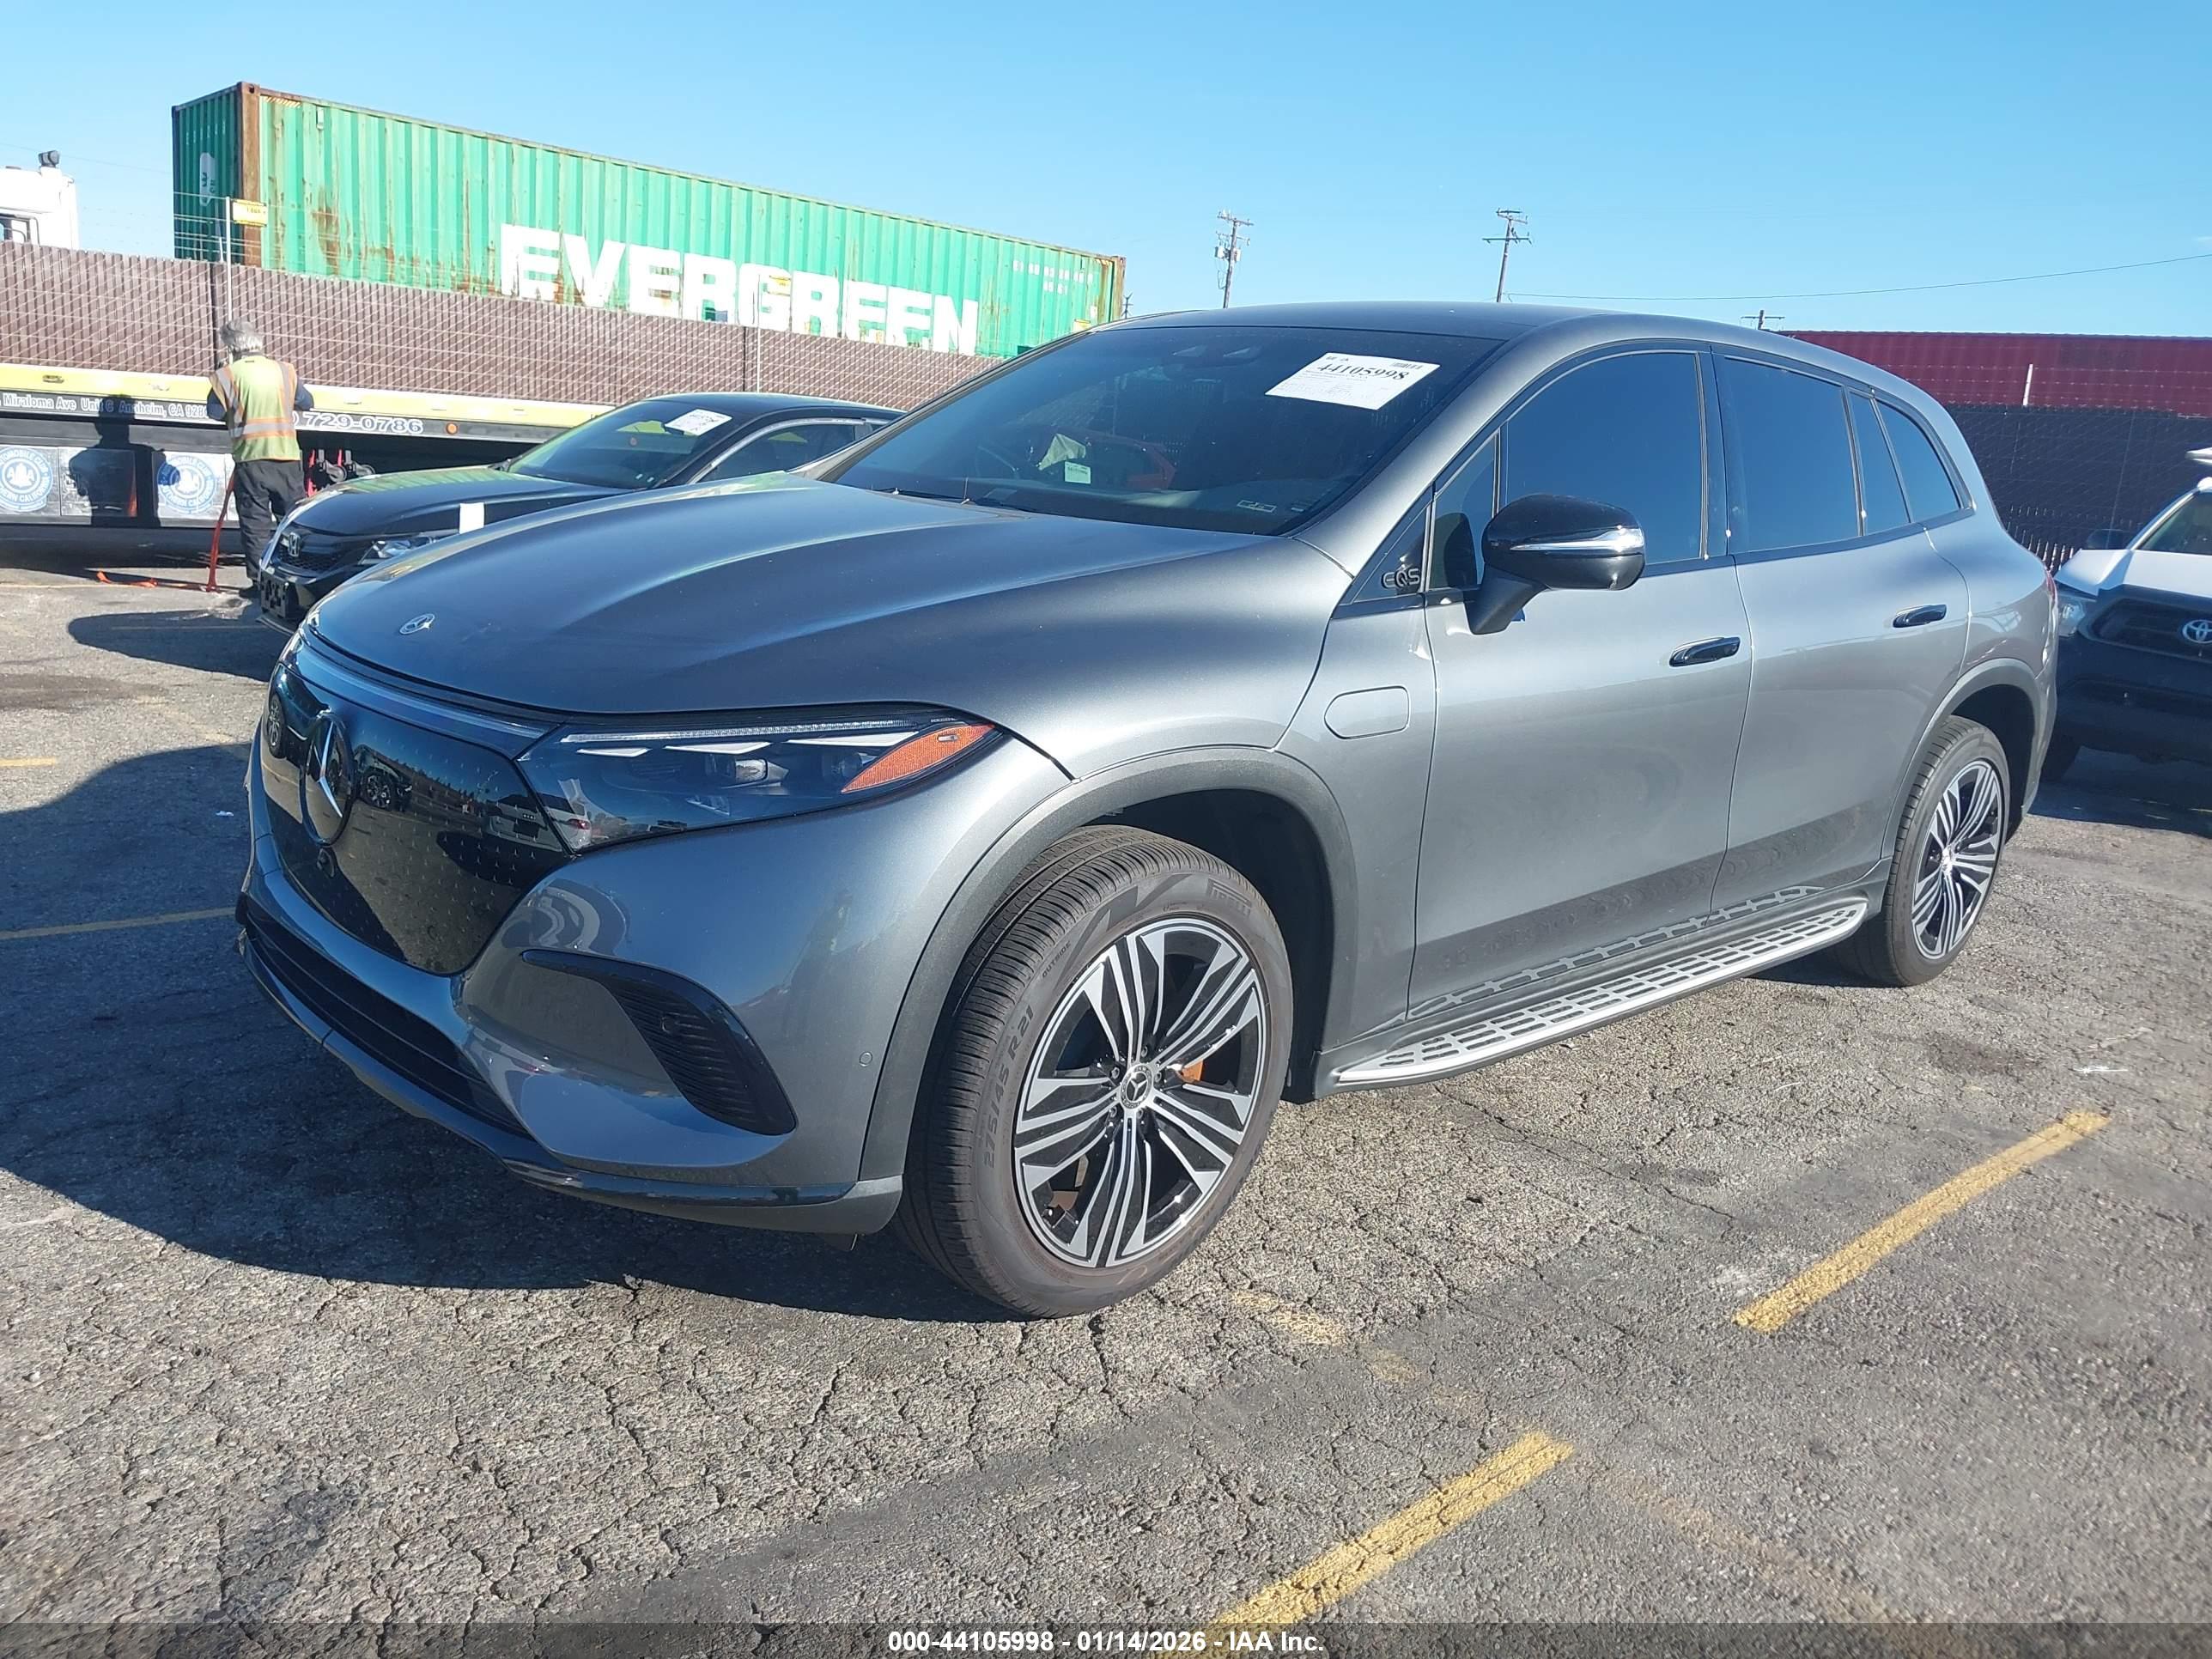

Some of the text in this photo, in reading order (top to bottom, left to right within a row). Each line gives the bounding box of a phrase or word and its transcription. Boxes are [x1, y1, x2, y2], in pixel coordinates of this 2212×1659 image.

[501, 223, 978, 356] EVERGREEN
[1317, 362, 1411, 380] 44105998
[3, 392, 55, 409] Miraloma
[56, 396, 77, 410] Ave
[81, 397, 104, 412] Unit
[118, 399, 167, 418] Anaheim,
[168, 403, 185, 417] CA
[303, 411, 423, 434] 729-0786
[1382, 567, 1420, 588] EQS
[1042, 940, 1071, 978] OUTSIDE
[983, 1063, 1010, 1169] 275/45
